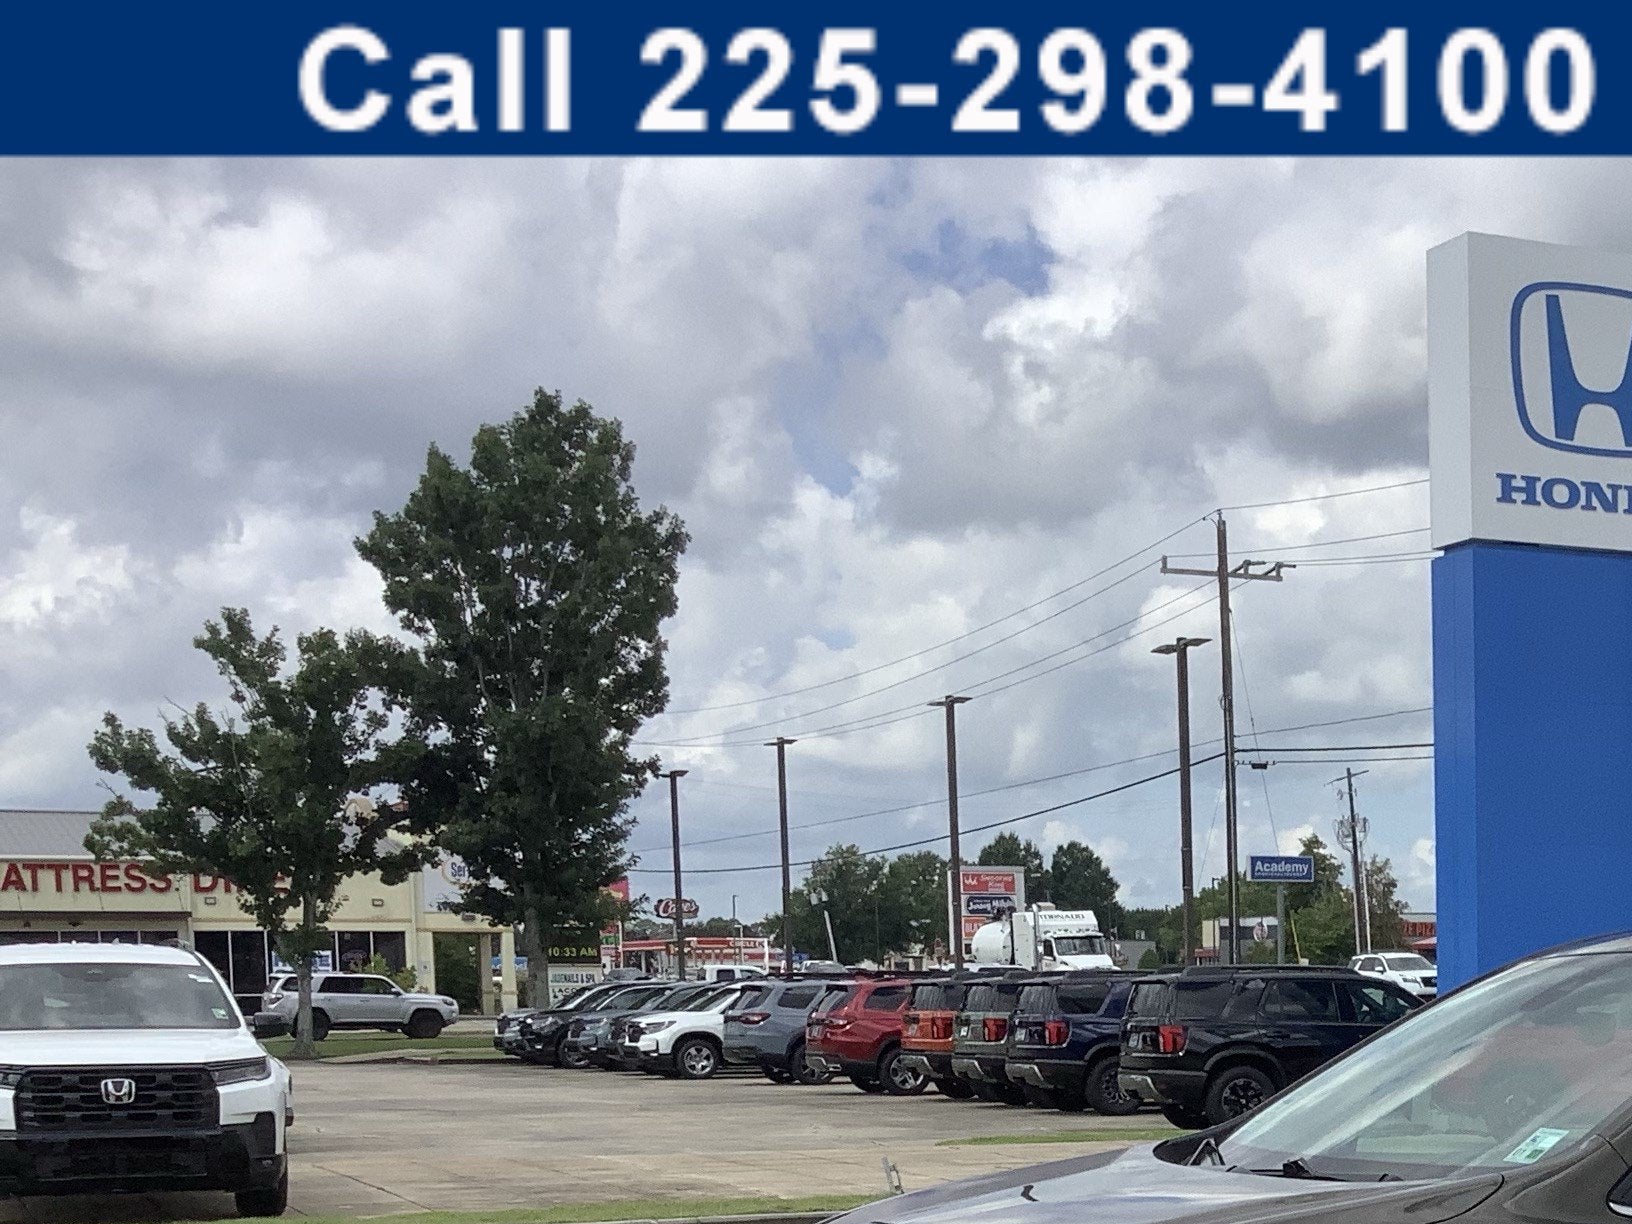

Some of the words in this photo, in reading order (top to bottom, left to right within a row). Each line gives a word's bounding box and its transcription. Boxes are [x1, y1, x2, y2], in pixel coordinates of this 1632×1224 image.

[1254, 860, 1309, 876] Academy
[0, 862, 172, 894] ATTRESS
[580, 947, 597, 957] AM
